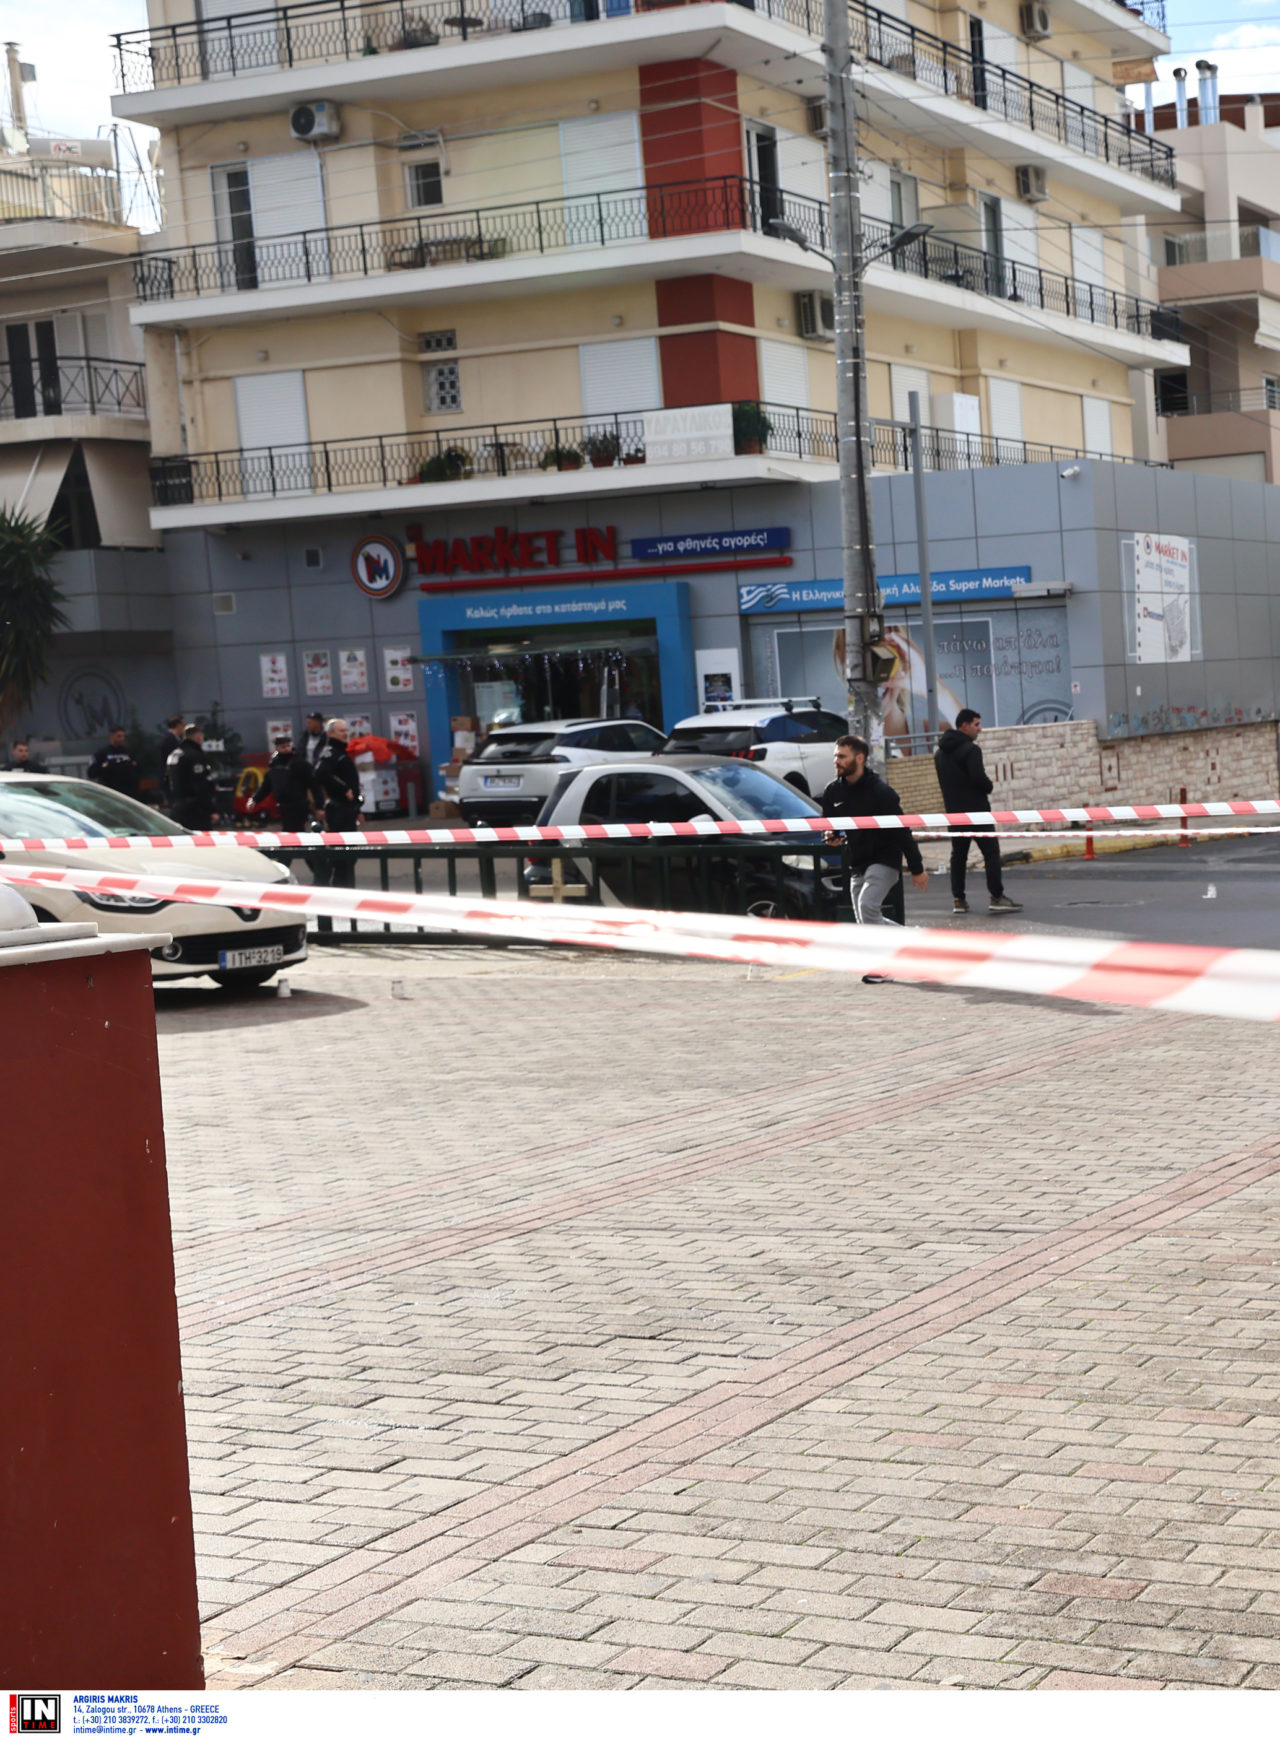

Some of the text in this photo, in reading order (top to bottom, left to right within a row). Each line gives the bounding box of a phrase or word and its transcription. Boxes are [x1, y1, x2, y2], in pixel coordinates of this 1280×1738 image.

[416, 526, 615, 574] MARKET IN
[677, 537, 719, 552] φθηνές
[722, 532, 768, 549] αγορές!
[949, 579, 979, 592] Super
[982, 576, 1025, 588] Markets
[466, 605, 498, 619] Καλώς
[500, 603, 533, 618] ήρθατε
